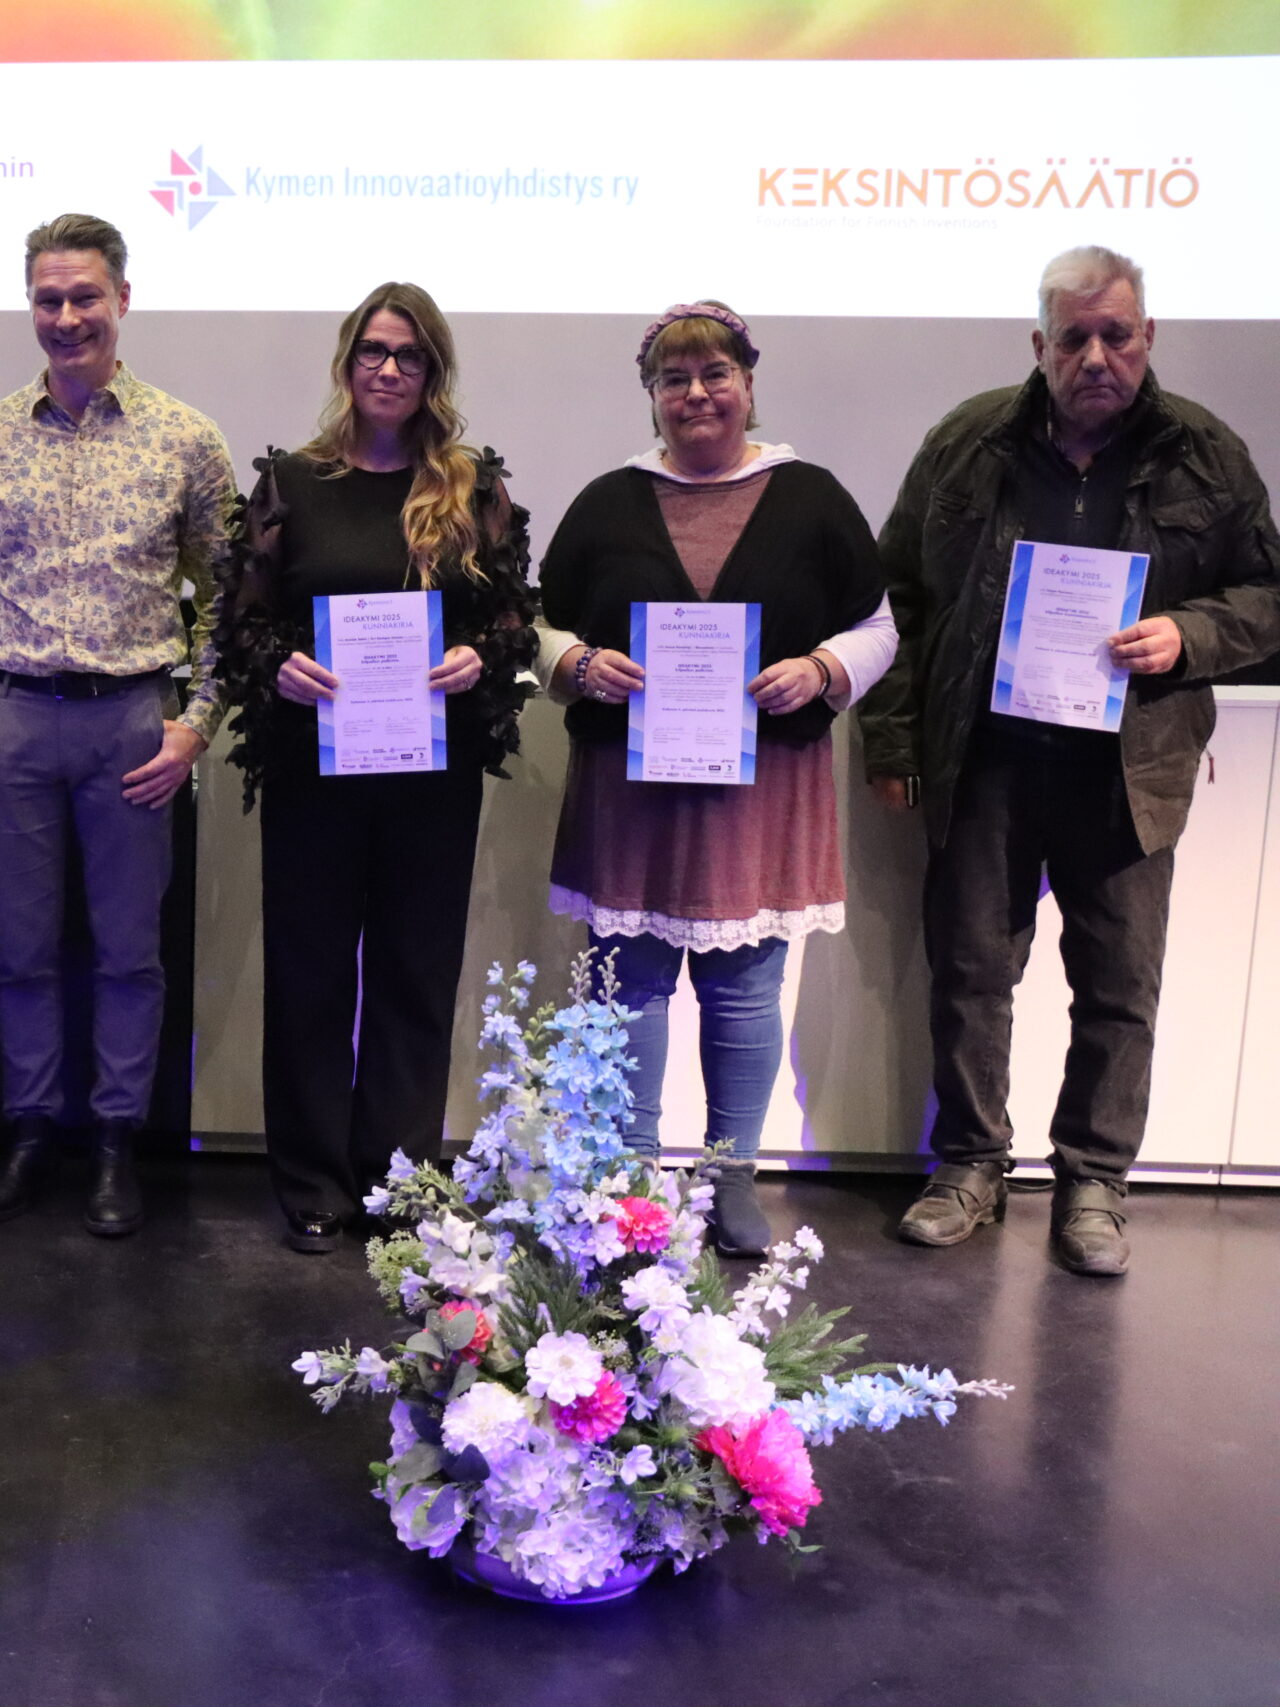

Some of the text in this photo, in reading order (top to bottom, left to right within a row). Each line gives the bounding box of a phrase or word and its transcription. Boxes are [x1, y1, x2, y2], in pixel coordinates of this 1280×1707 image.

[245, 167, 639, 205] Kymen Innovaatioyhdistys ry
[757, 157, 1200, 208] KEKSINTÖSÄÄTIÖ
[343, 613, 401, 624] IDEAKYMI 2025
[659, 623, 718, 631] IDEAKYMI 2025
